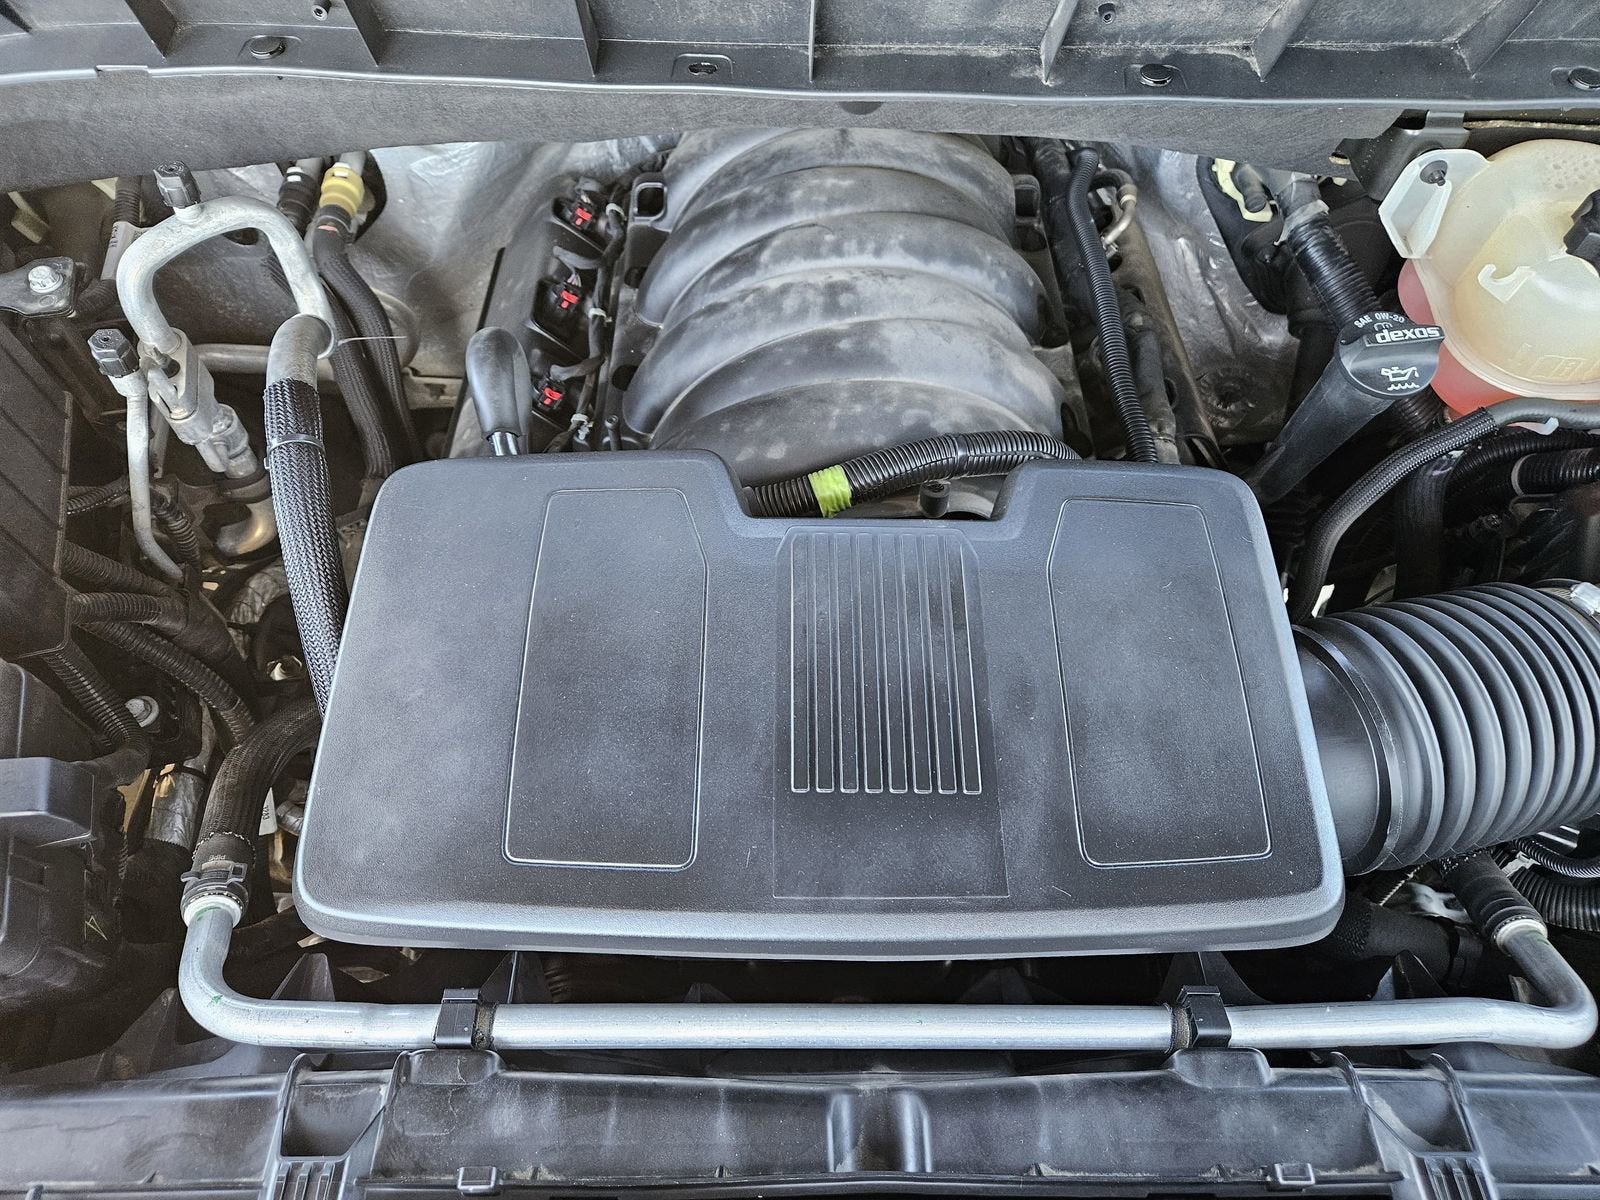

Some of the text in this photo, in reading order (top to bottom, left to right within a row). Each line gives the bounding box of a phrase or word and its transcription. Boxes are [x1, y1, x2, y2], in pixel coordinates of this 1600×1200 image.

[1354, 312, 1405, 328] SAE 0W-20
[1375, 327, 1440, 343] dexos
